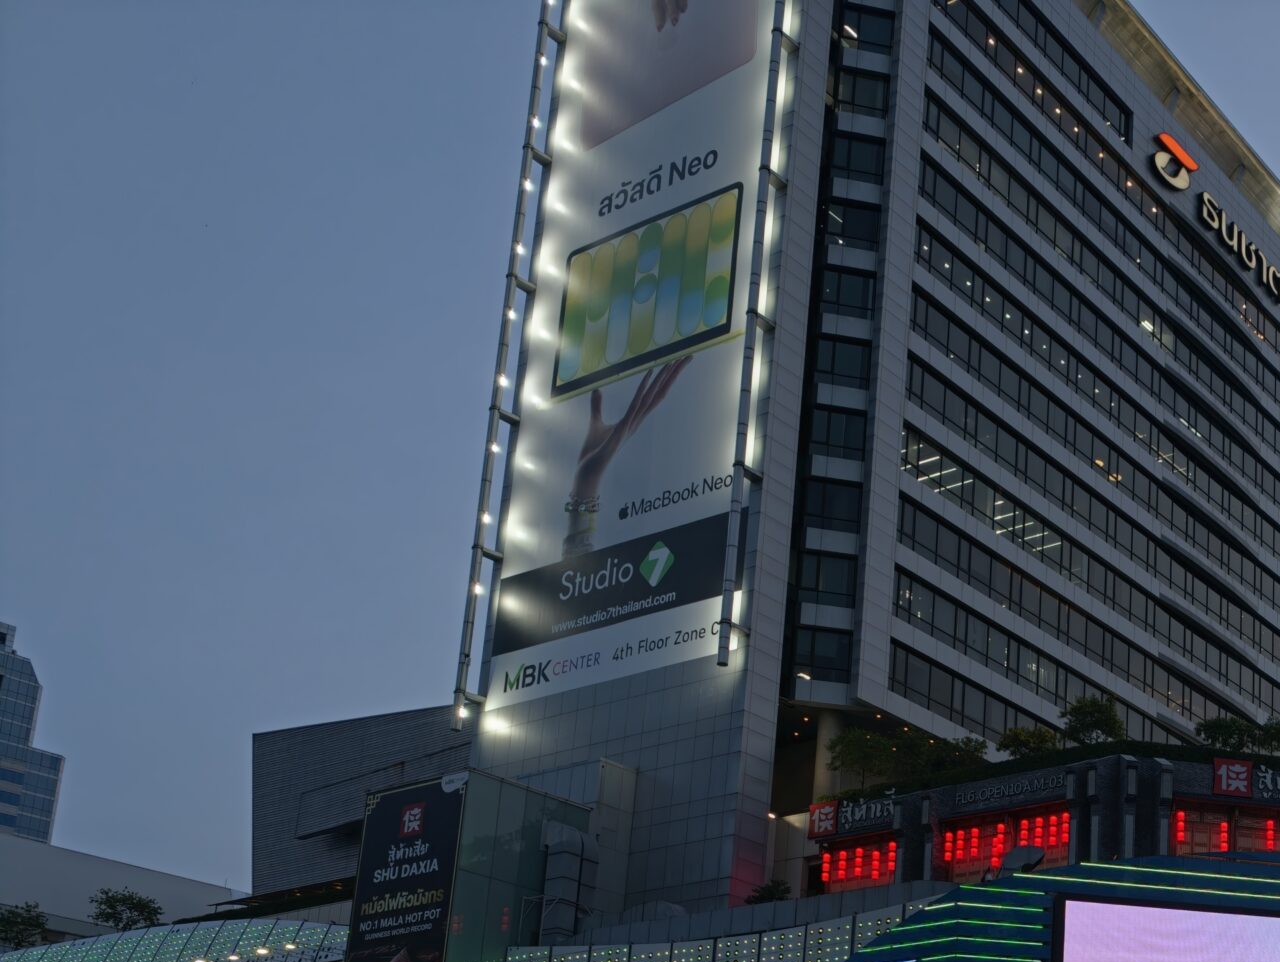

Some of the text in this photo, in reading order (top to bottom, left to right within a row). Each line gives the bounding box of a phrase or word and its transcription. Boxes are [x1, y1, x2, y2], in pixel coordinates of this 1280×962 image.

[597, 149, 719, 217] สวัสดี Neo
[629, 473, 733, 518] MacBook Neo
[559, 558, 634, 601] Studio
[551, 590, 676, 634] www.studio7thailand.com
[503, 659, 552, 693] MBK
[552, 651, 601, 677] CENTER
[611, 642, 634, 662] 4th
[637, 632, 671, 654] Floor
[673, 626, 706, 646] Zone
[373, 858, 439, 883] SHU DAXIA
[359, 908, 442, 932] NO.1 MALA HOT POT
